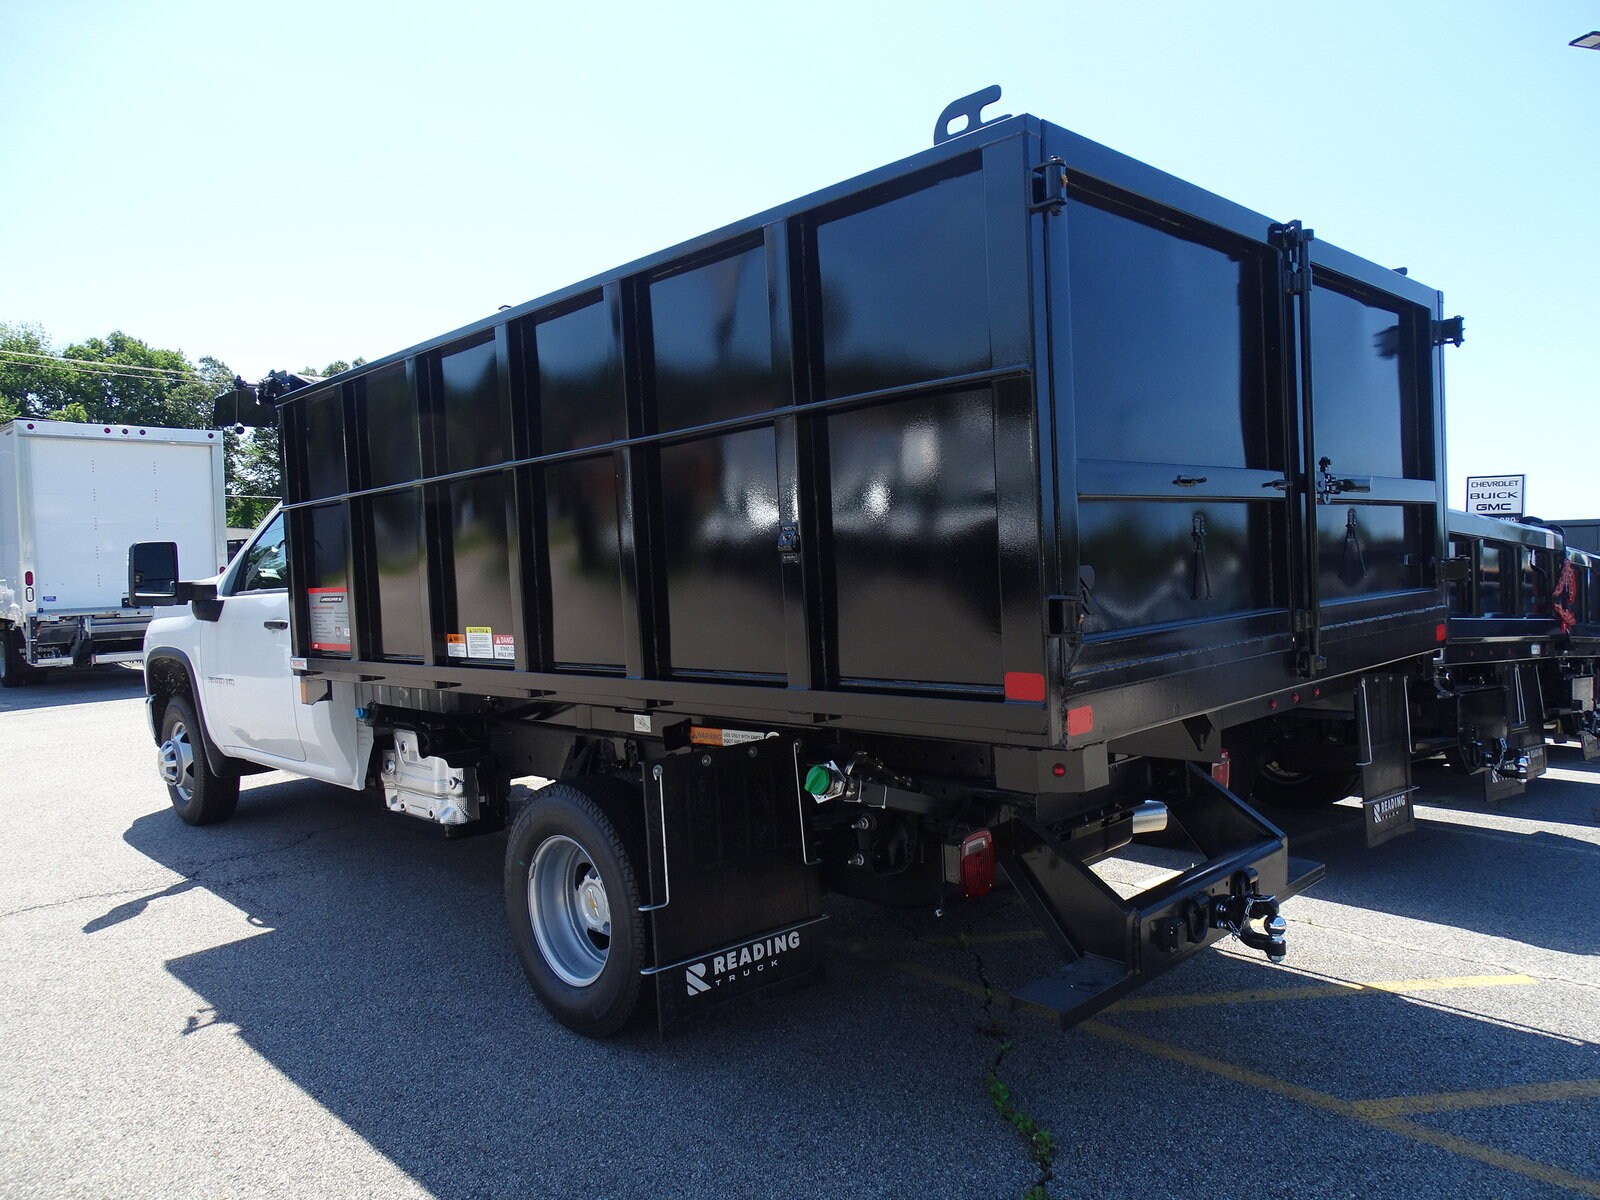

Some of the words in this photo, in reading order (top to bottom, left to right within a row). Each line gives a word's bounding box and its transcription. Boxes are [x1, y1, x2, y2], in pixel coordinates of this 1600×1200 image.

[1471, 480, 1519, 488] CHEVROLET
[1476, 503, 1512, 511] GMC
[1380, 794, 1406, 813] READING
[713, 931, 801, 975] READING
[715, 959, 779, 987] TRUCK
